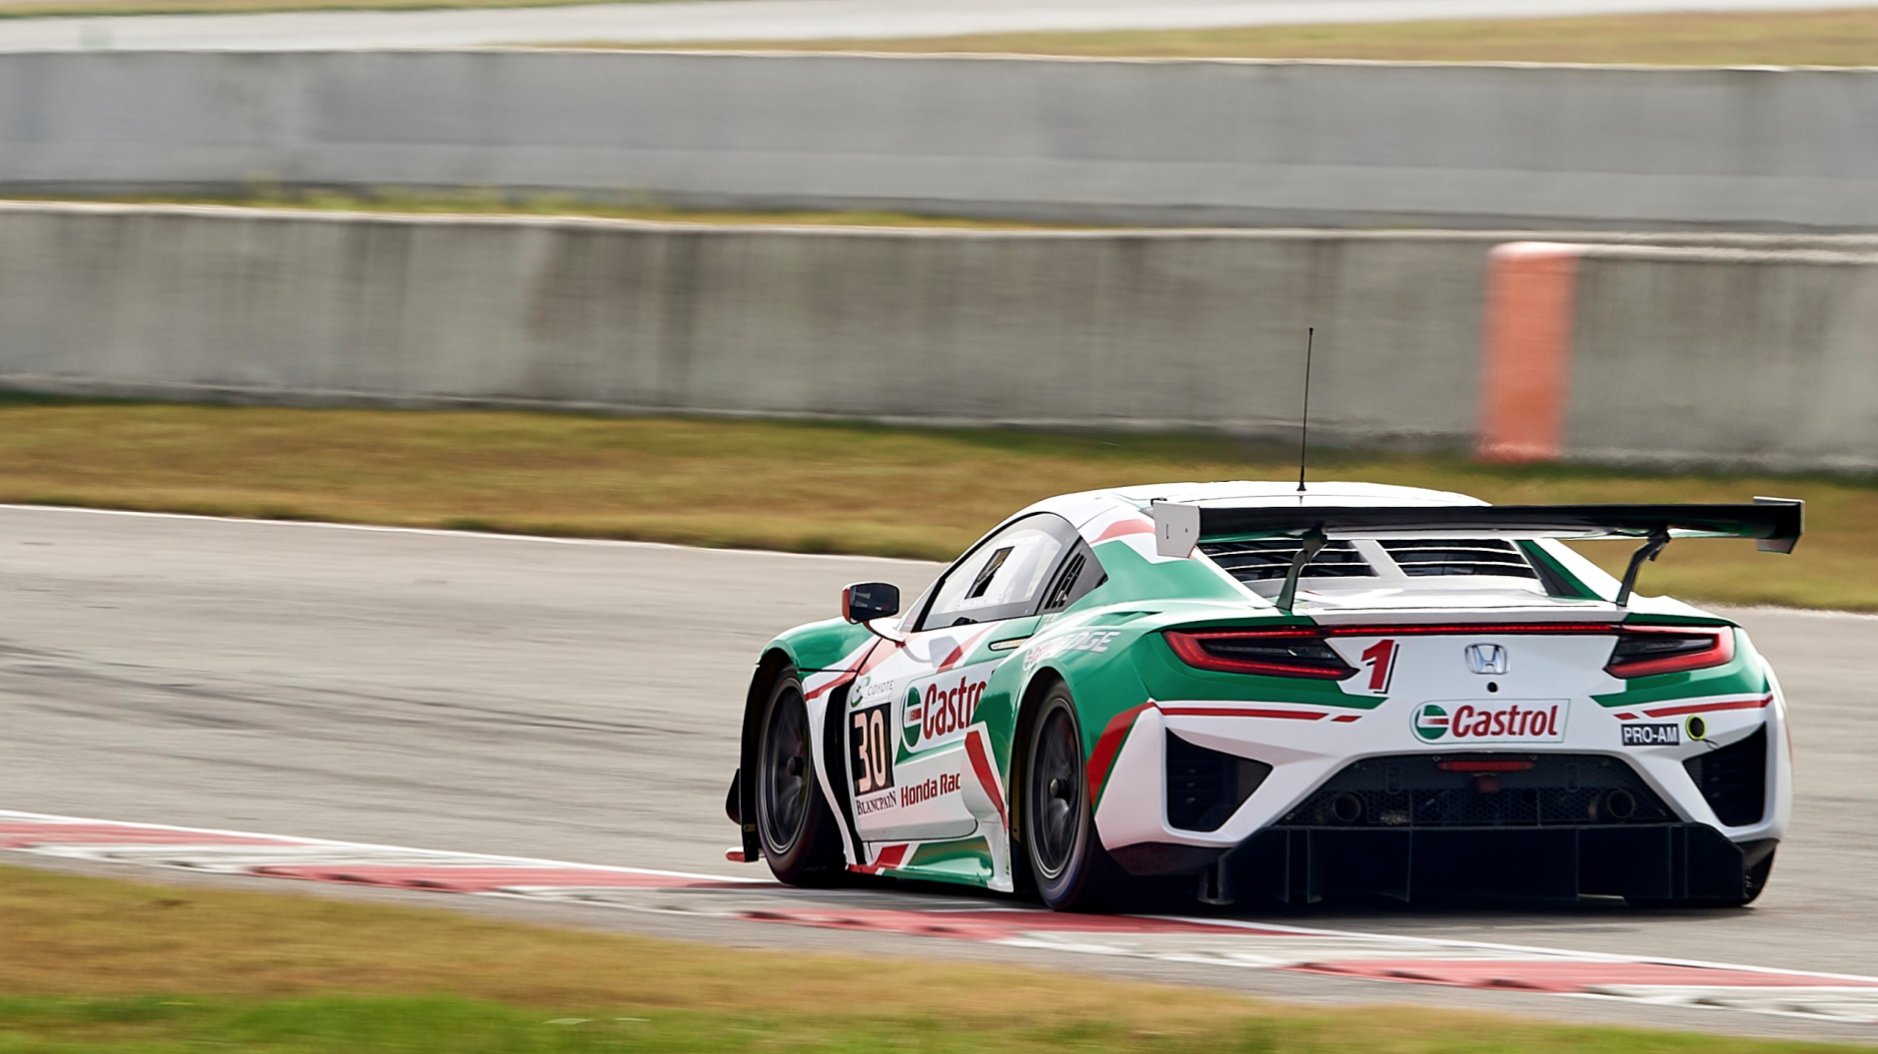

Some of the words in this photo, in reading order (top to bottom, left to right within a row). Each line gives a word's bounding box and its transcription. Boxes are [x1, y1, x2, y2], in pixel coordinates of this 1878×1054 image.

[1361, 639, 1400, 694] 1
[867, 680, 894, 696] COYOTE
[923, 670, 995, 740] Castr
[1452, 705, 1558, 738] Castrol
[1623, 726, 1678, 743] PRO-AM
[854, 709, 886, 793] 30
[855, 791, 897, 815] BLANCPAIN
[901, 778, 938, 808] Honda
